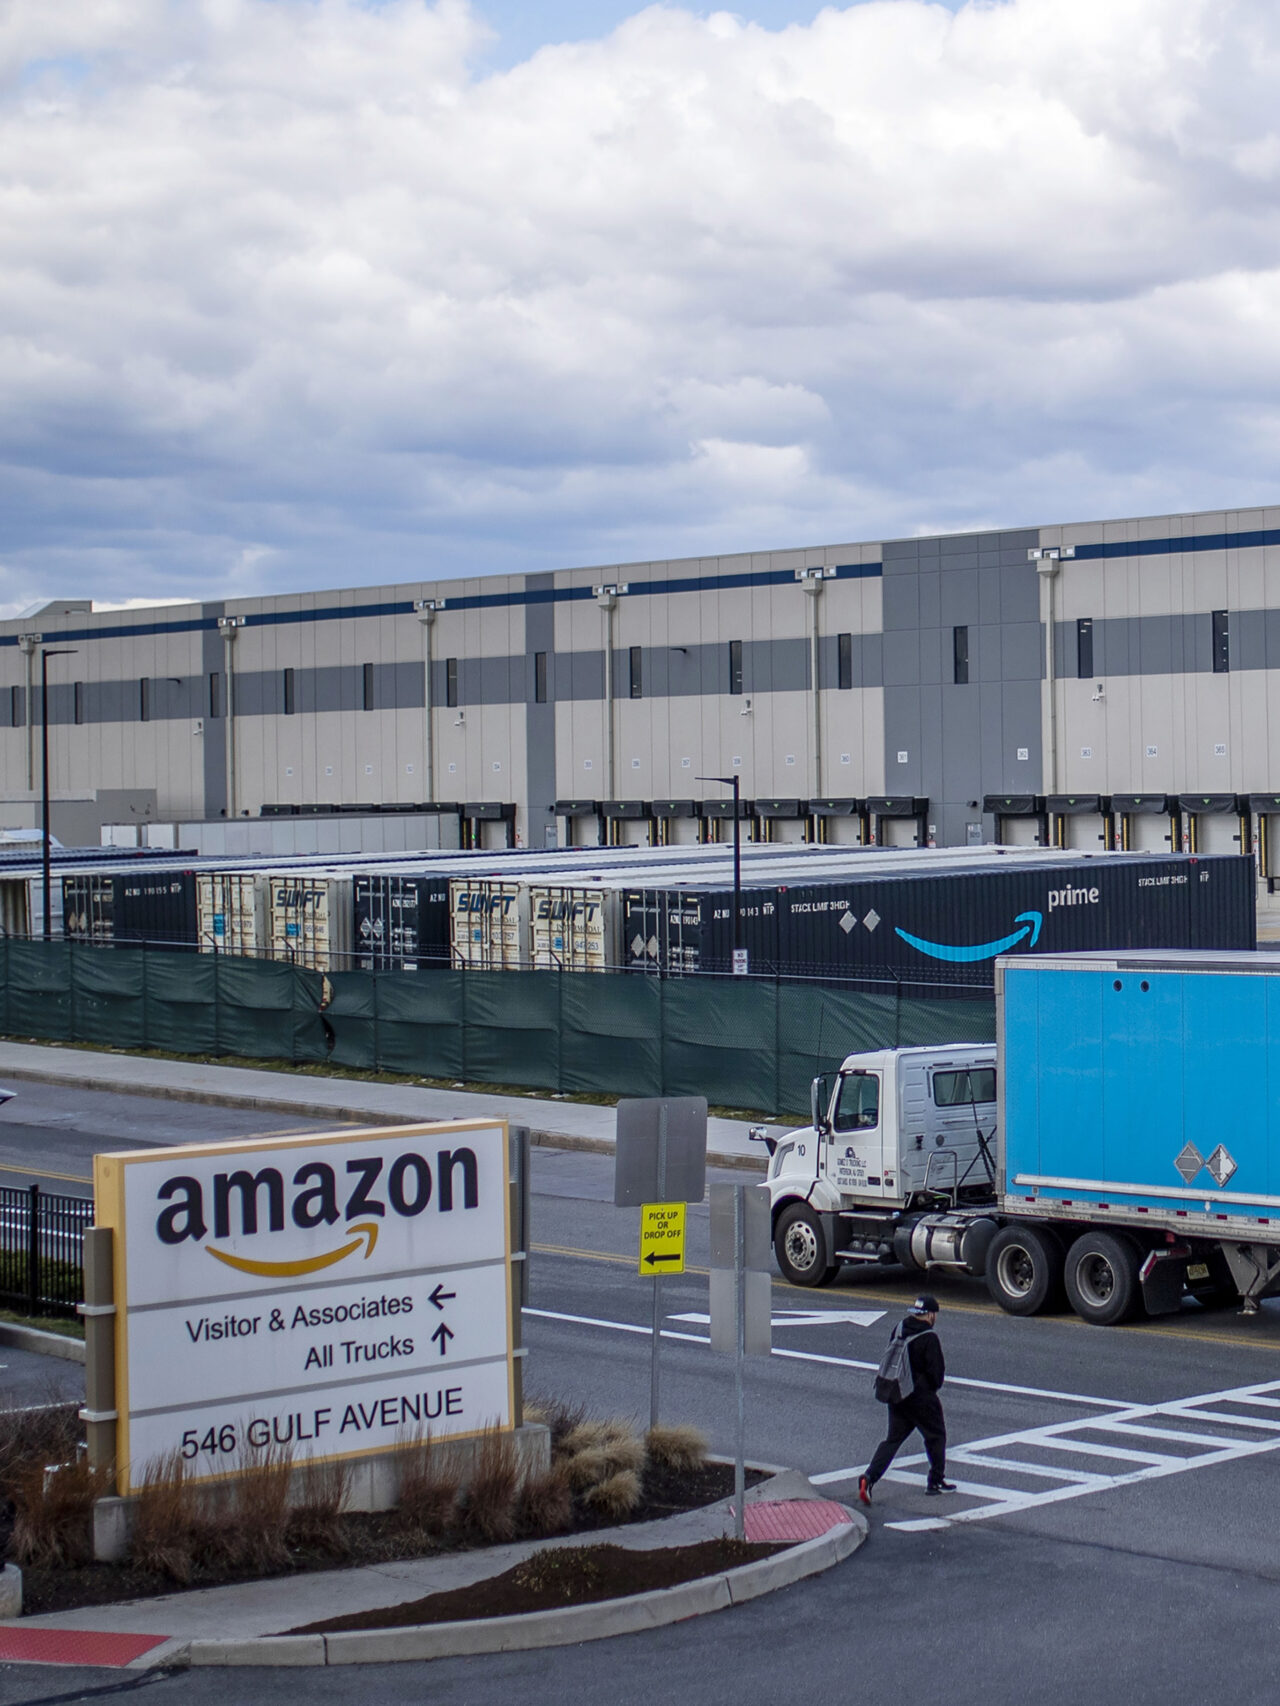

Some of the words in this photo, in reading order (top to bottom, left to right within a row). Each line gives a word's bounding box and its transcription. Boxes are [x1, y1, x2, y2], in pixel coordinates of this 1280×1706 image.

[457, 893, 516, 915] SWIFT
[1048, 884, 1099, 912] prime
[537, 900, 600, 922] SWIFT
[797, 1144, 806, 1156] 10
[156, 1146, 479, 1245] amazon
[648, 1211, 665, 1220] PICK
[667, 1211, 679, 1219] UP
[657, 1220, 668, 1230] OR
[644, 1230, 665, 1239] DROP
[667, 1229, 681, 1238] OFF
[186, 1316, 261, 1344] Visitor
[268, 1309, 285, 1331] &
[291, 1292, 413, 1329] Associates
[304, 1344, 333, 1370] All
[341, 1335, 415, 1365] Trucks
[181, 1424, 236, 1460] 546
[246, 1408, 331, 1448] GULF
[340, 1387, 463, 1434] AVENUE
